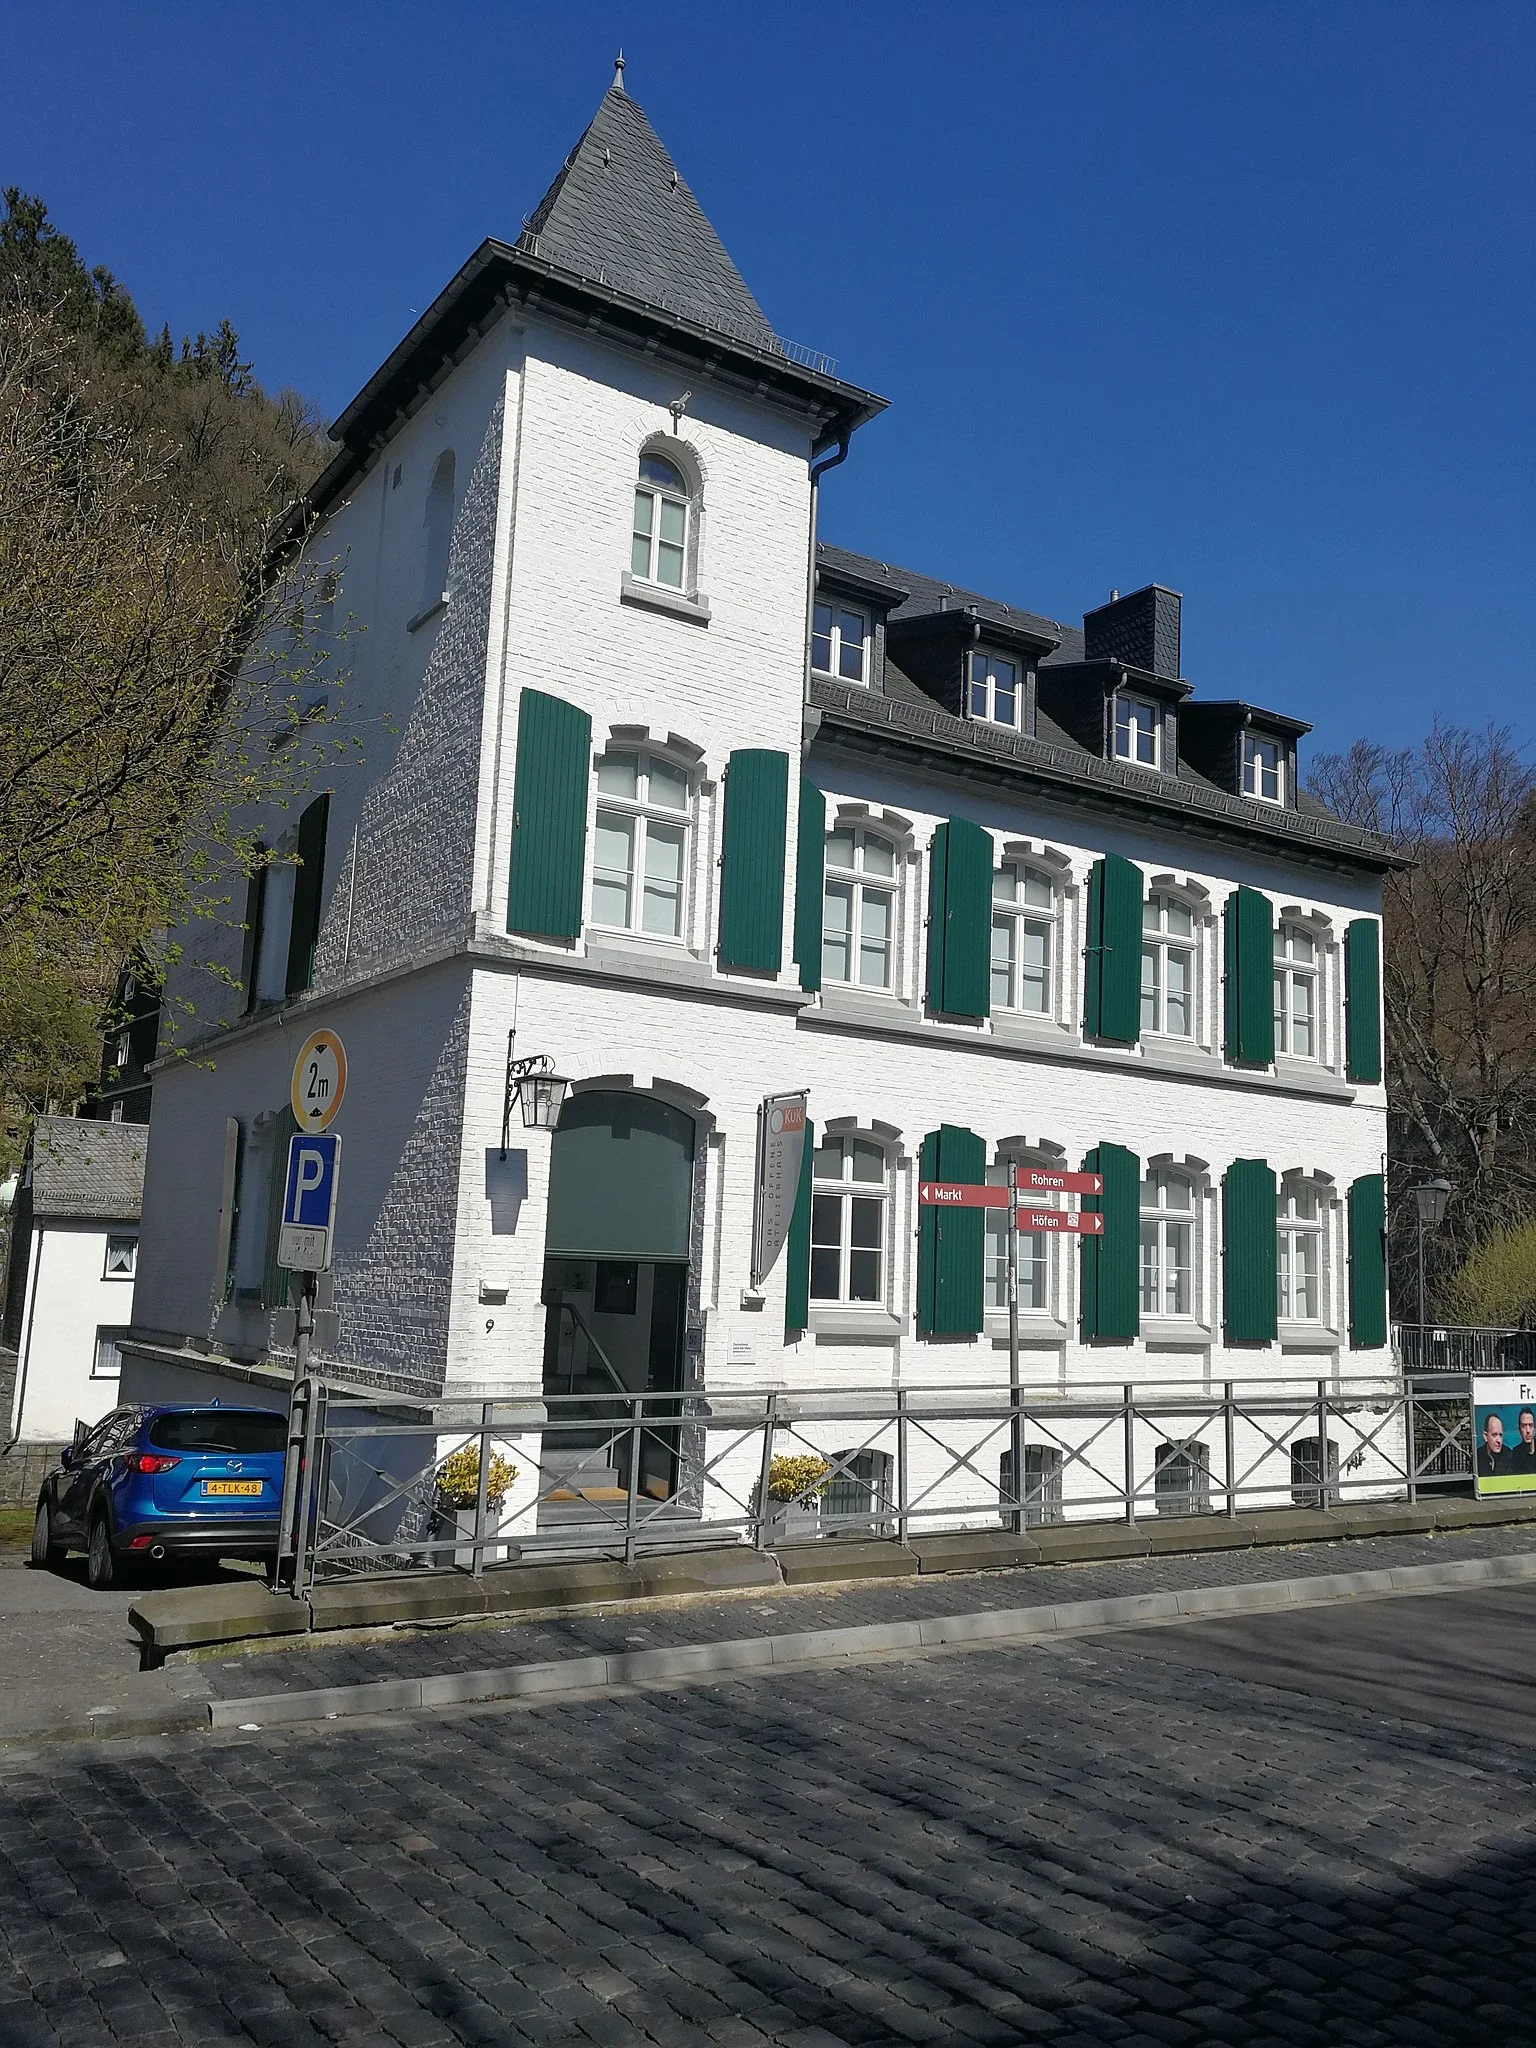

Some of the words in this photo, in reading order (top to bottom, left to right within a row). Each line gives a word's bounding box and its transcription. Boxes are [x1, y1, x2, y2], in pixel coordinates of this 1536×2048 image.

[768, 1141, 776, 1200] OFFENE
[293, 1149, 324, 1223] P
[1031, 1173, 1064, 1187] Rohren
[774, 1140, 783, 1247] ATELIERHAUS
[934, 1187, 962, 1201] Markt
[1031, 1214, 1059, 1227] Höfen
[766, 1218, 774, 1247] DAS
[485, 1319, 495, 1334] 9
[1520, 1384, 1534, 1400] Fr.
[211, 1483, 258, 1494] 4-TLK-48
